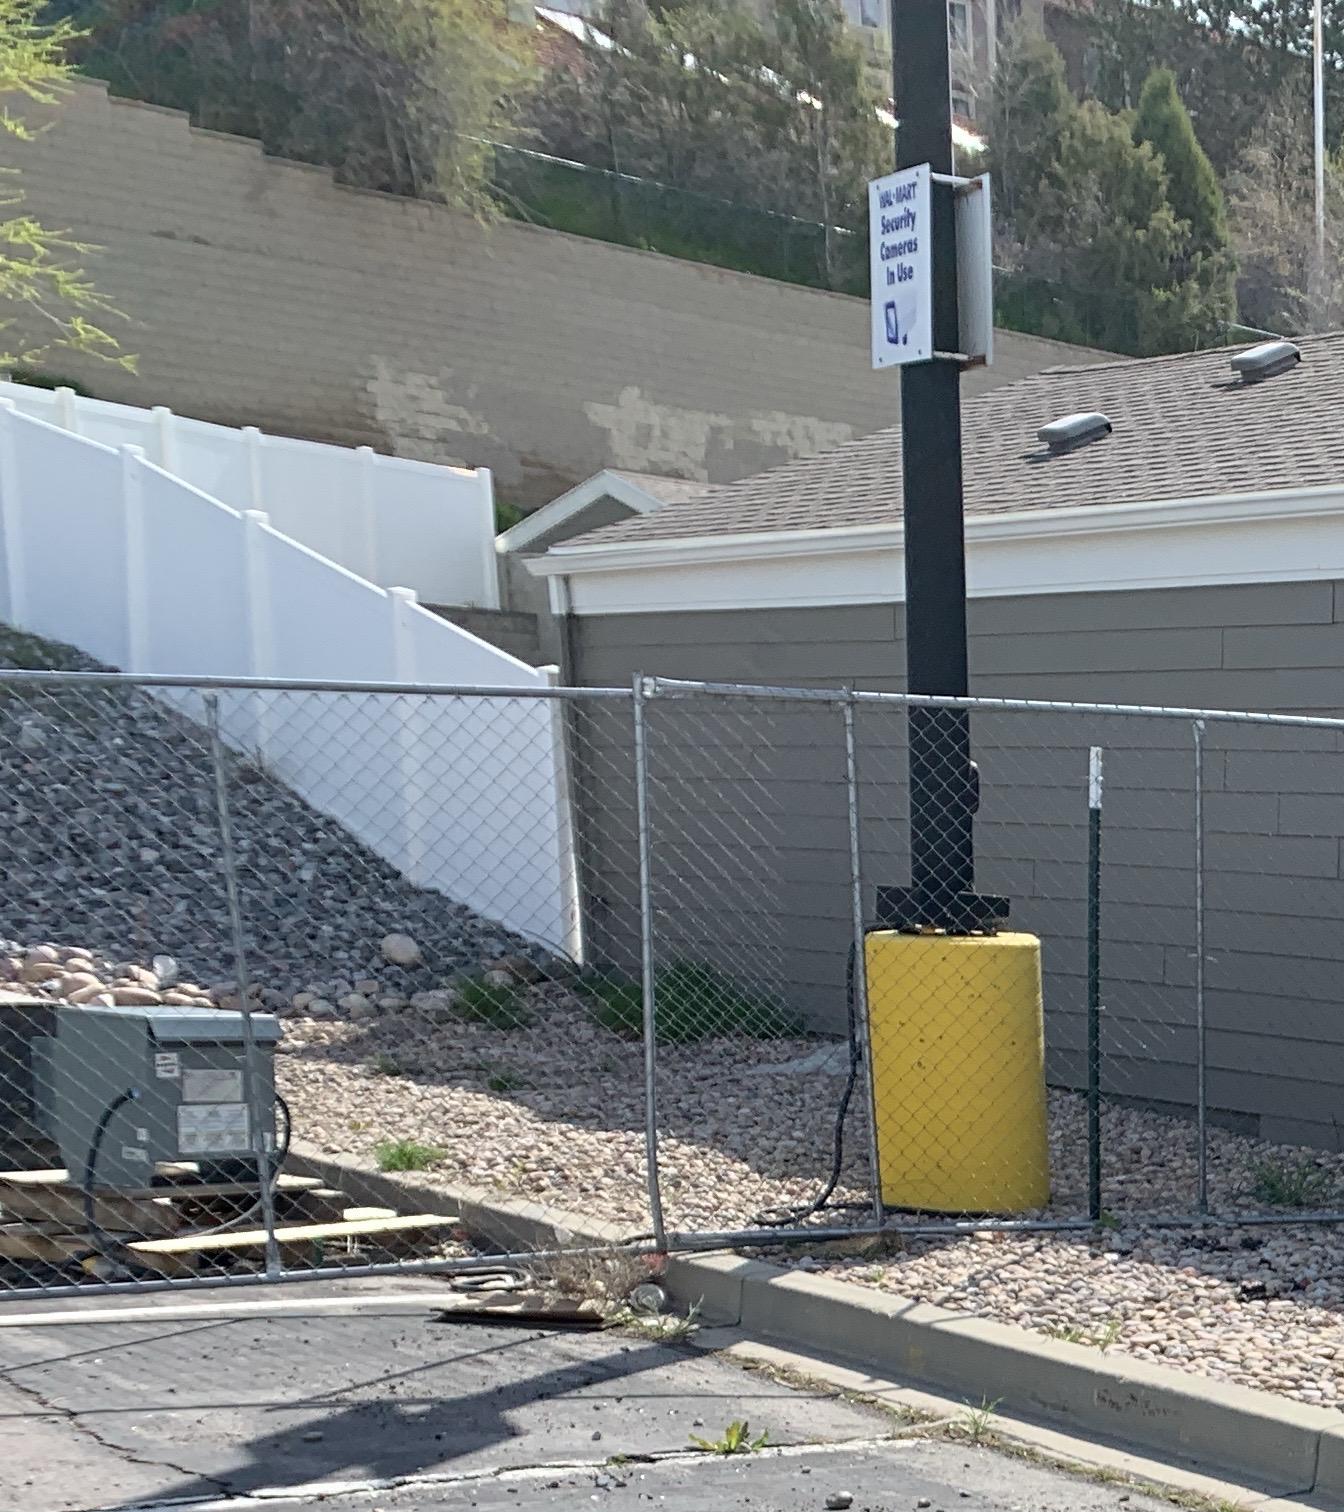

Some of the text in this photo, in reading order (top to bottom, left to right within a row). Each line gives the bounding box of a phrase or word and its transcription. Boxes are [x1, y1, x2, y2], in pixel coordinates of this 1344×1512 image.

[881, 206, 916, 235] Security
[881, 237, 918, 262] Cameras
[887, 262, 914, 286] In Use
